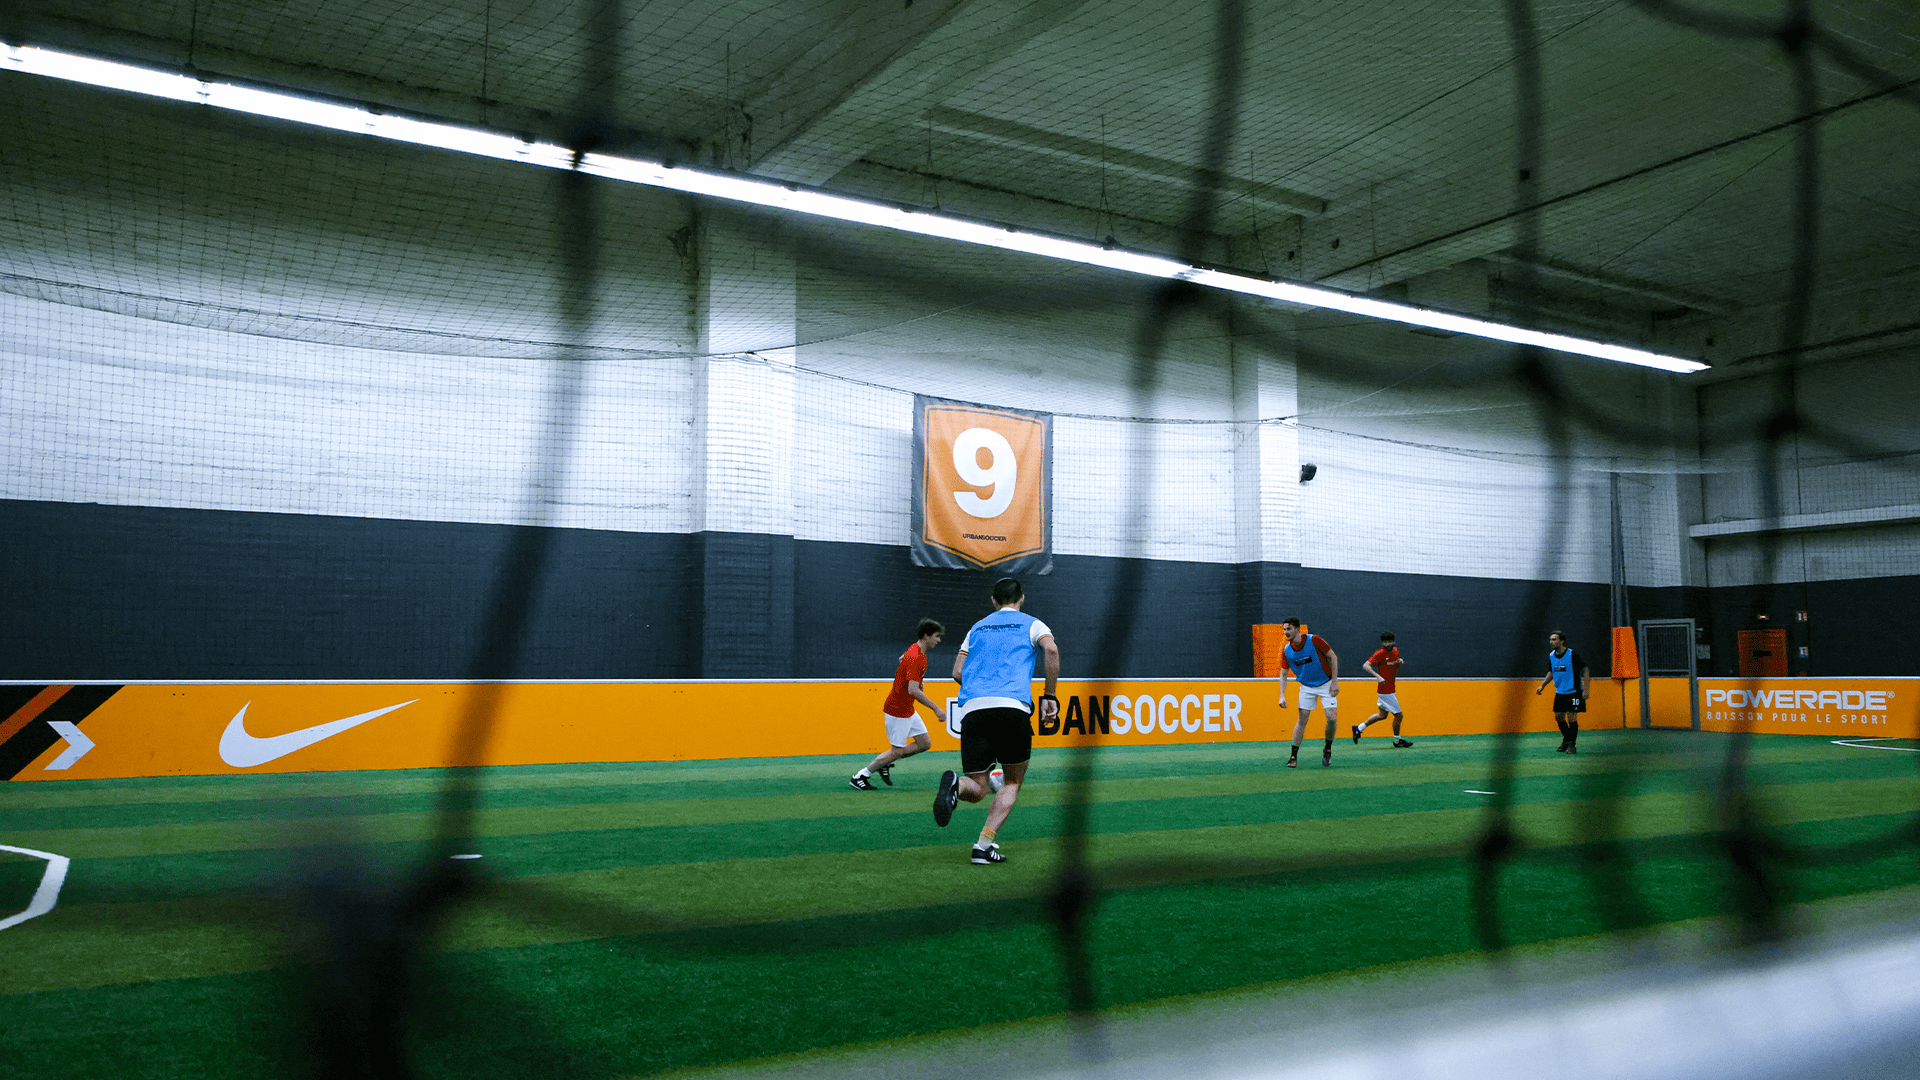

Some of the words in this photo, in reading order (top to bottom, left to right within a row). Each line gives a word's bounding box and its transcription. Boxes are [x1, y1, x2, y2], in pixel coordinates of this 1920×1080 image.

[953, 427, 1017, 519] 9
[962, 533, 1007, 542] URBANSOCCER
[1707, 711, 1763, 721] BOISSON
[1772, 713, 1806, 722] POUR
[1816, 713, 1831, 723] LE
[1841, 714, 1887, 724] SPORT
